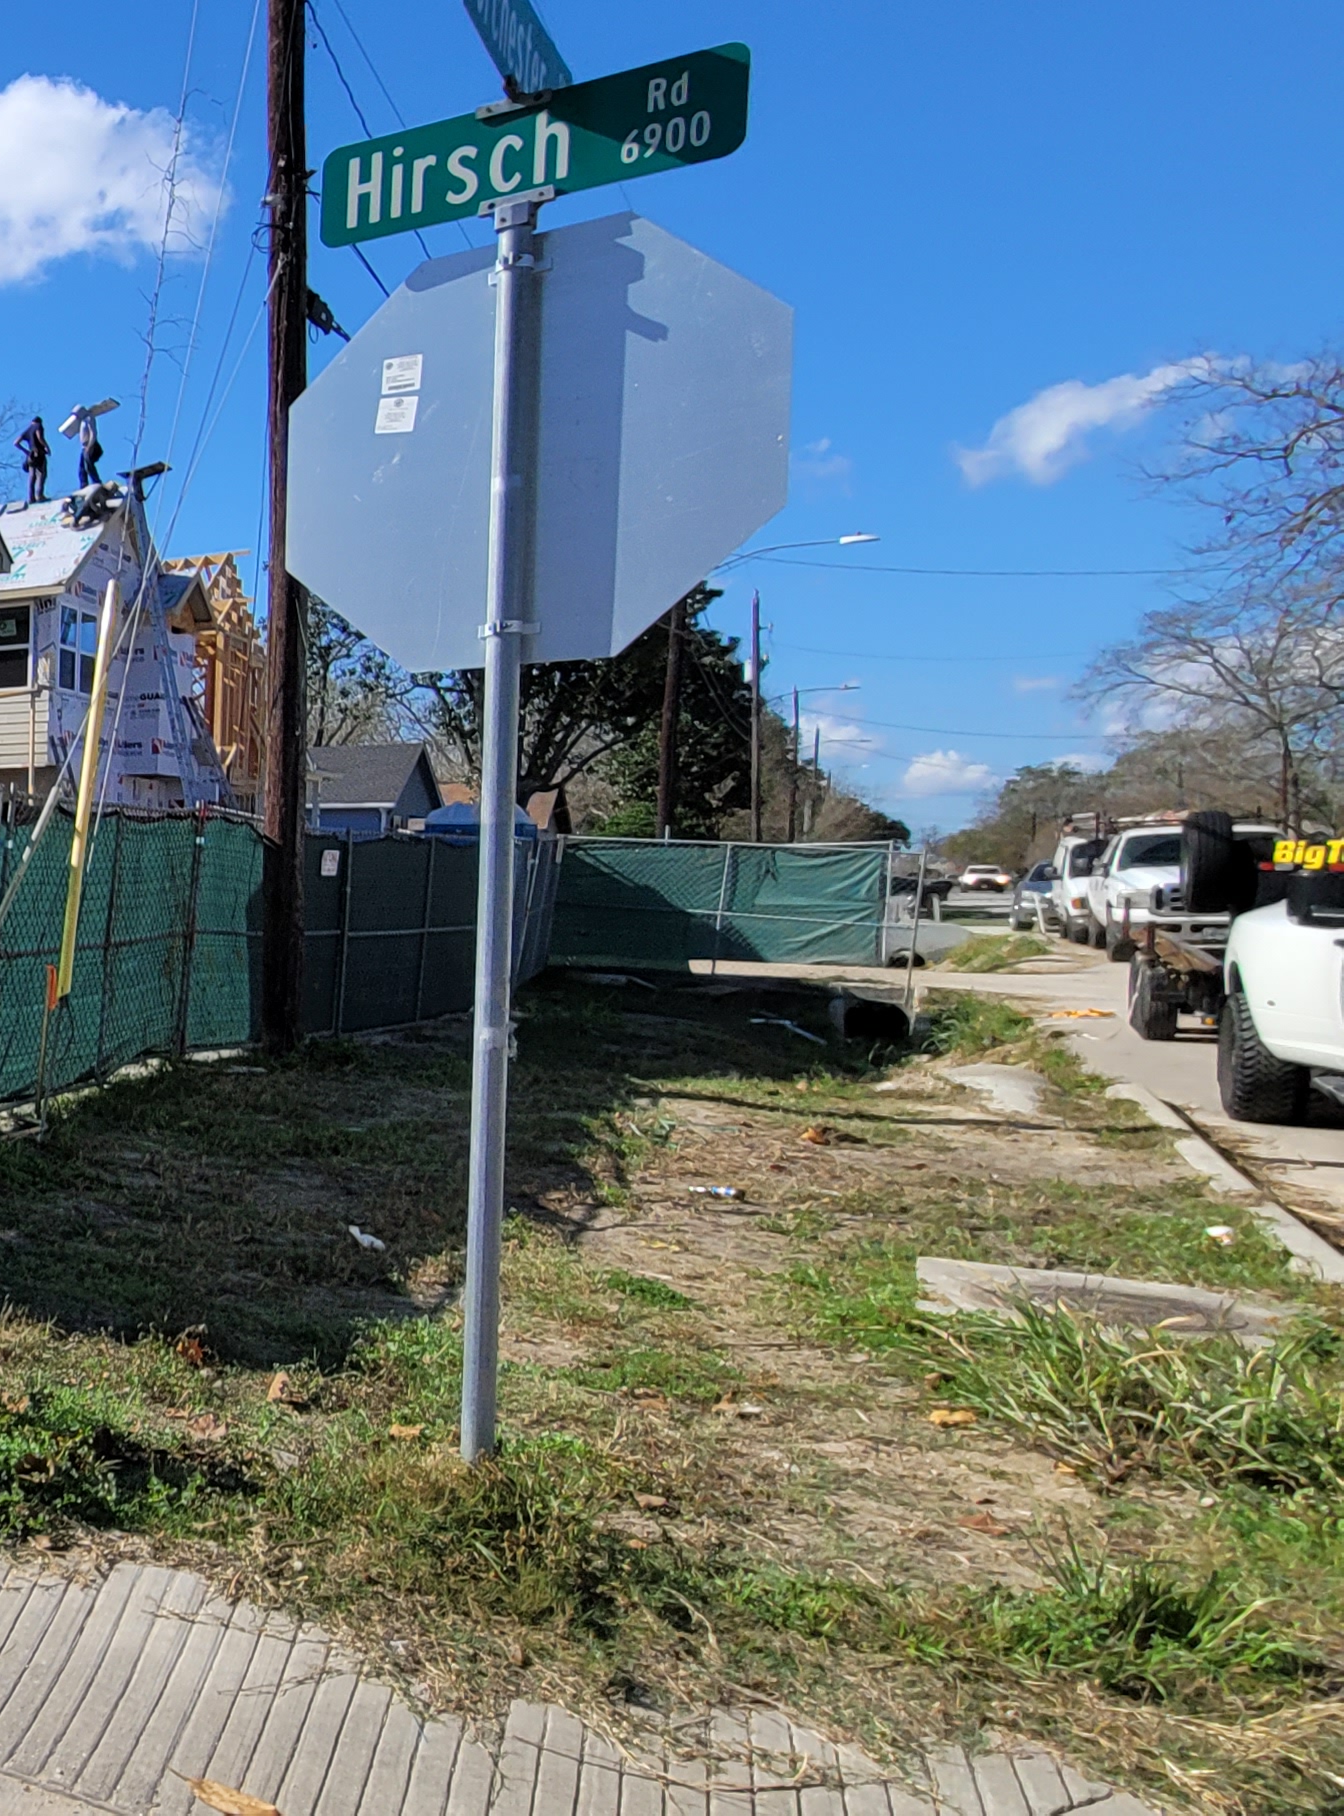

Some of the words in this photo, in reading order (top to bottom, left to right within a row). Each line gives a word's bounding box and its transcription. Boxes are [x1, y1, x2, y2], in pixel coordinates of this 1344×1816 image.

[346, 110, 570, 229] Hirsch
[647, 70, 690, 113] Rd
[620, 111, 711, 164] 6900
